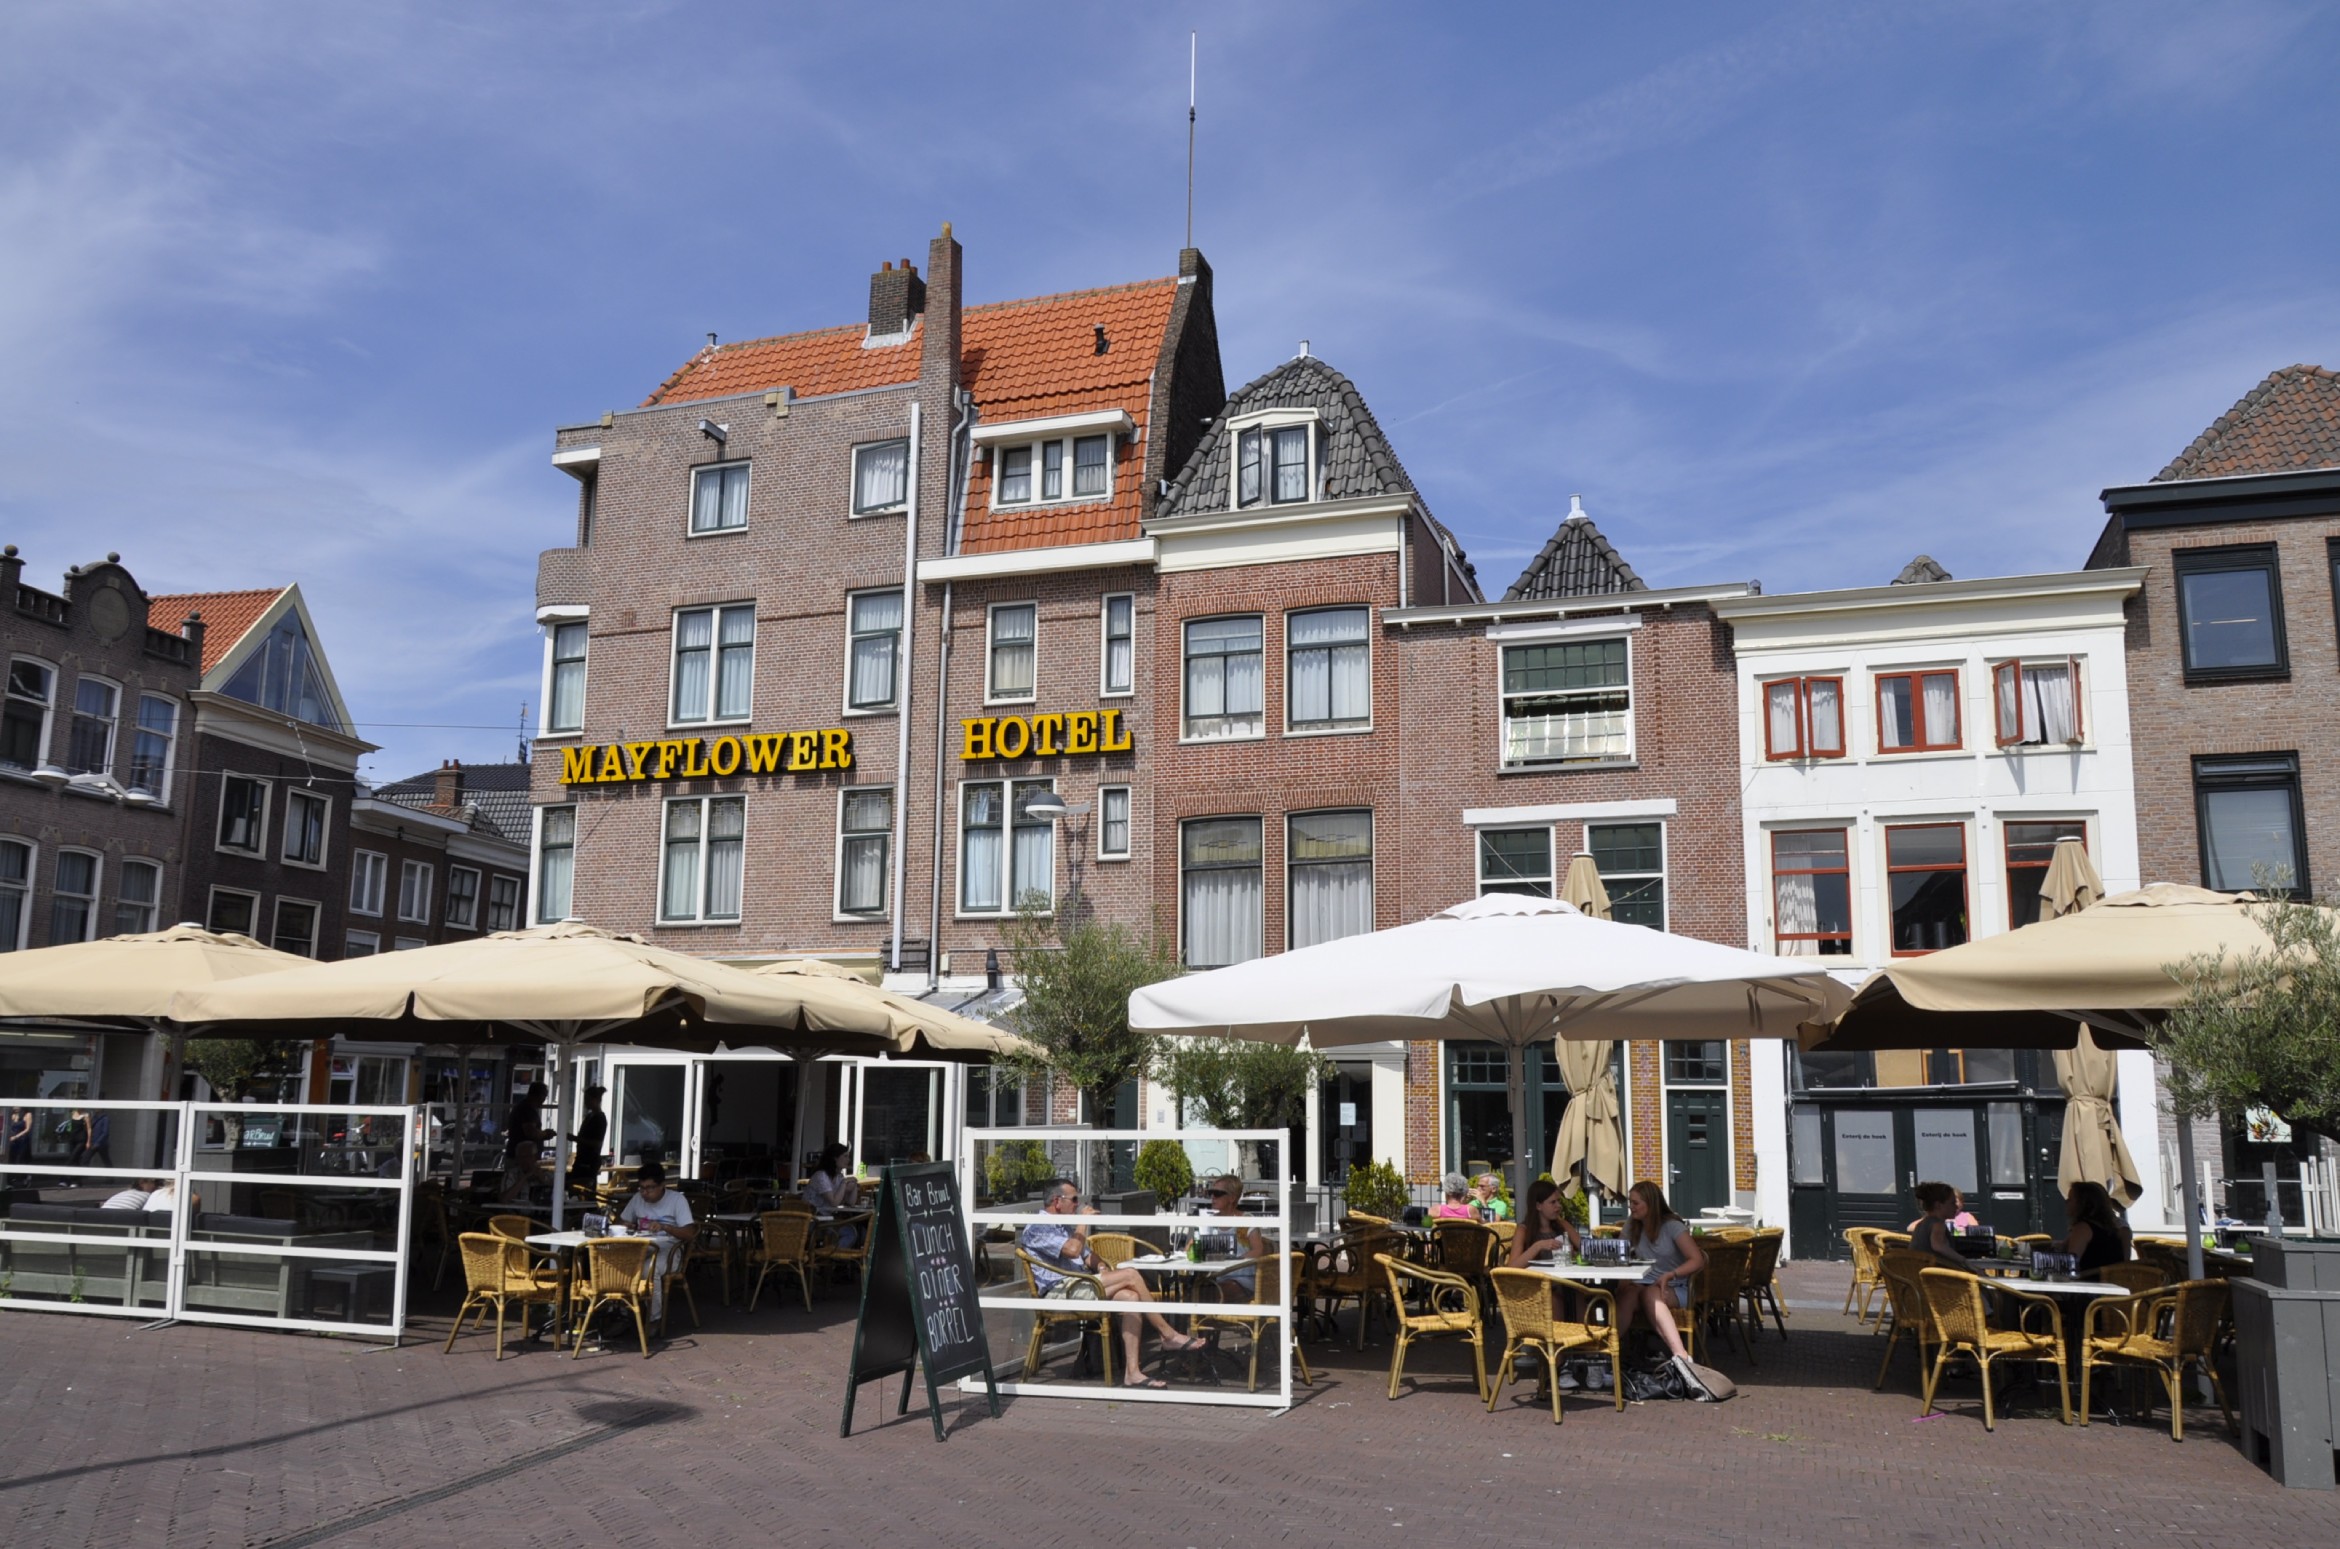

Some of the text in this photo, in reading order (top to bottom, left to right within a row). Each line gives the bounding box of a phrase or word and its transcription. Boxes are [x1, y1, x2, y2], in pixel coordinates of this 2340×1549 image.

[560, 709, 1132, 784] MAYFLOWER HOTEL
[905, 1183, 922, 1207] Bar
[911, 1223, 956, 1257] LUNCH
[927, 1307, 974, 1352] BORREL
